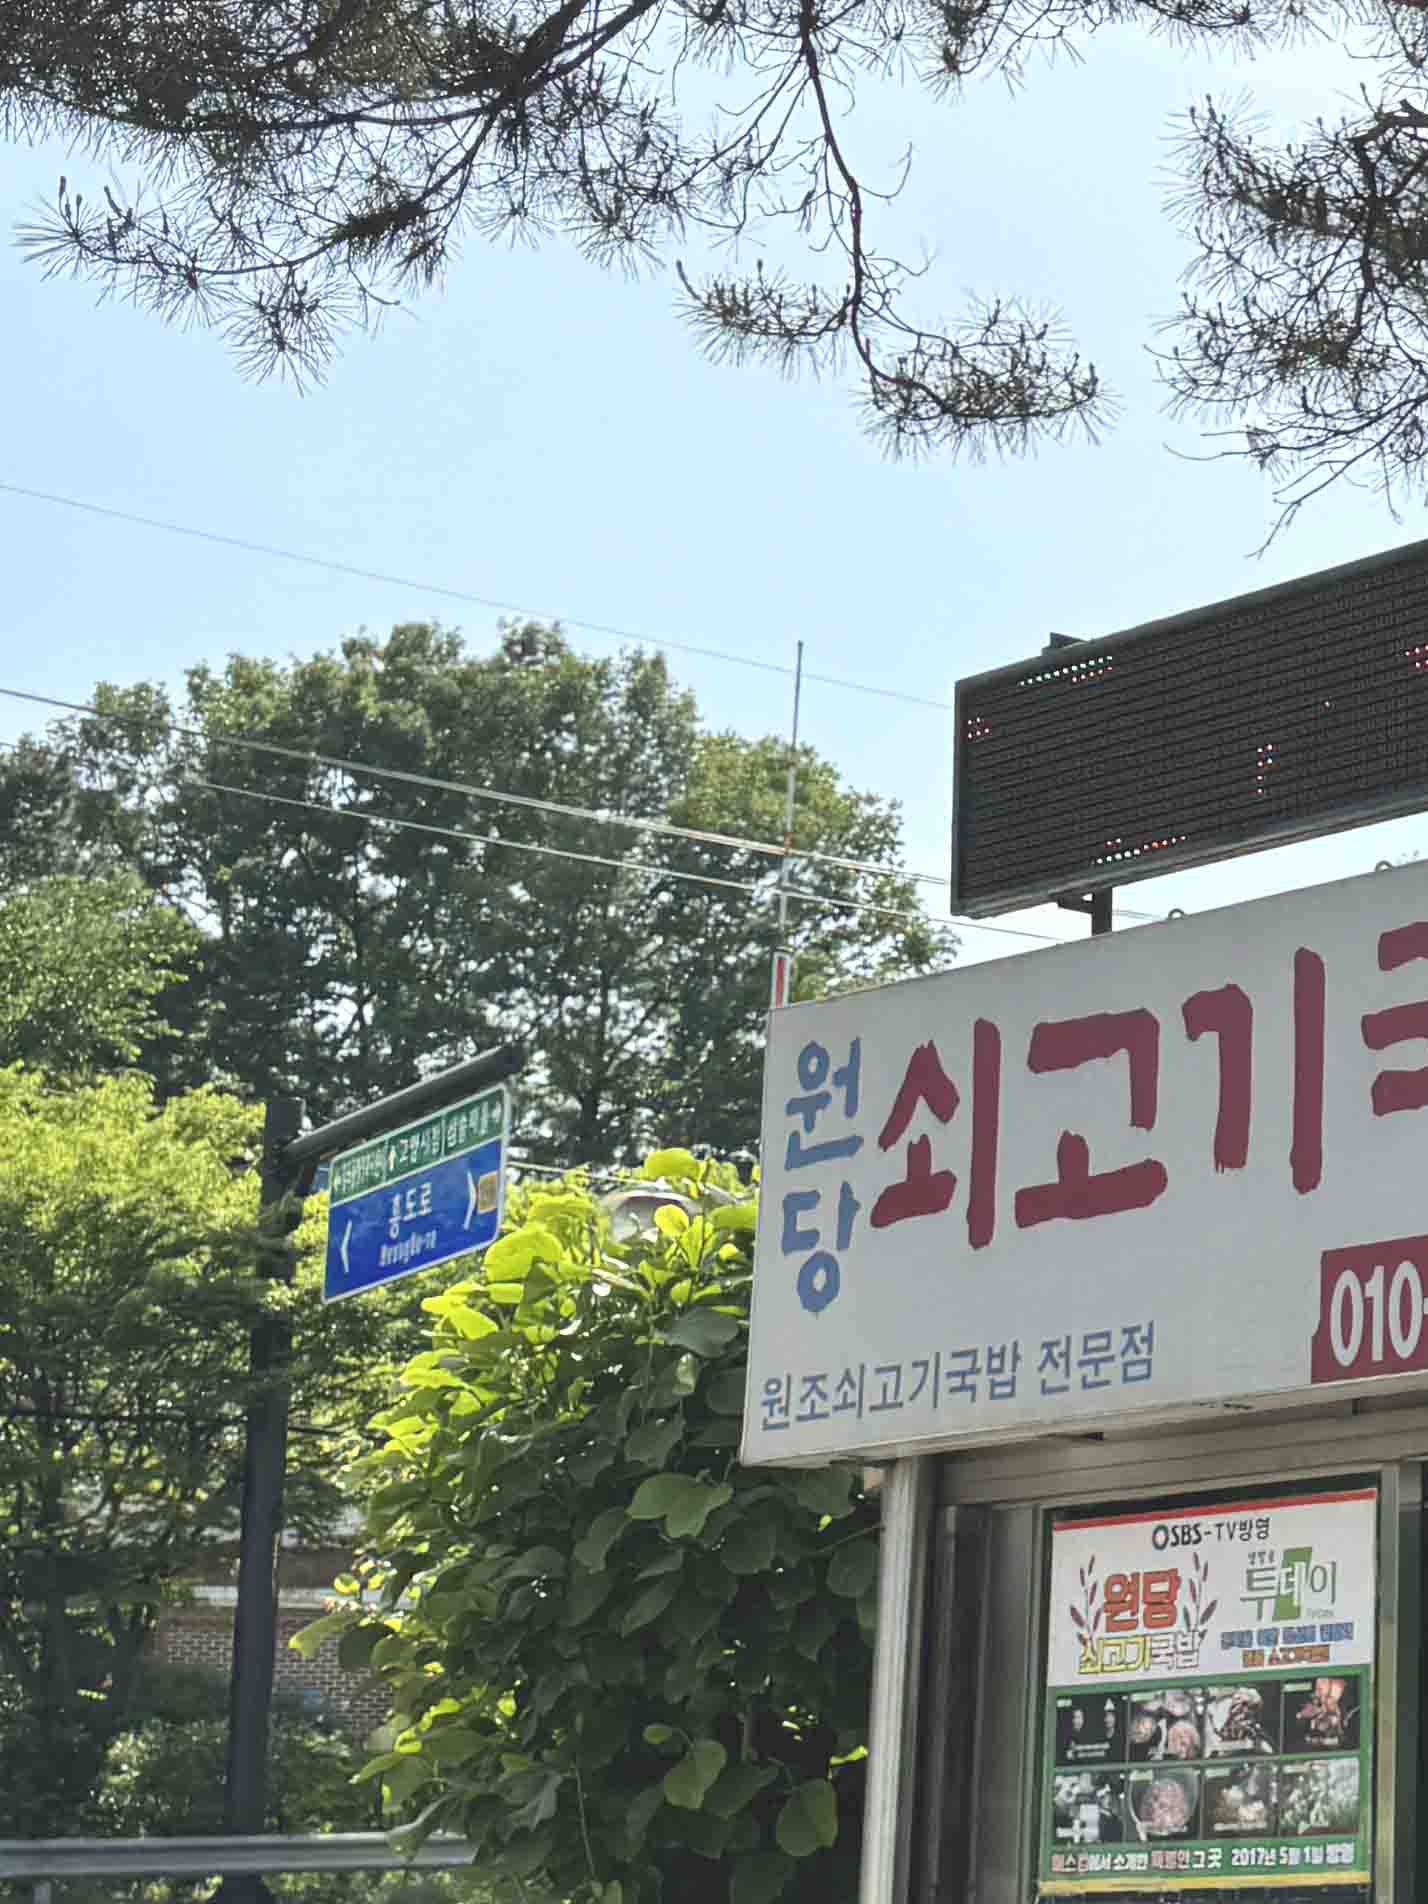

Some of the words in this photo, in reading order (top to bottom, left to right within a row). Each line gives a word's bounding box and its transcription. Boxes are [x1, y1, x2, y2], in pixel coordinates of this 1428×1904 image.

[781, 1036, 865, 1313] 원당
[760, 1339, 1022, 1432] 원조쇠고기국밥
[1037, 1319, 1154, 1396] 전문점
[1103, 1567, 1182, 1632] 원당
[1239, 1560, 1336, 1622] 투데이
[1077, 1631, 1202, 1675] 쇠고기국밥
